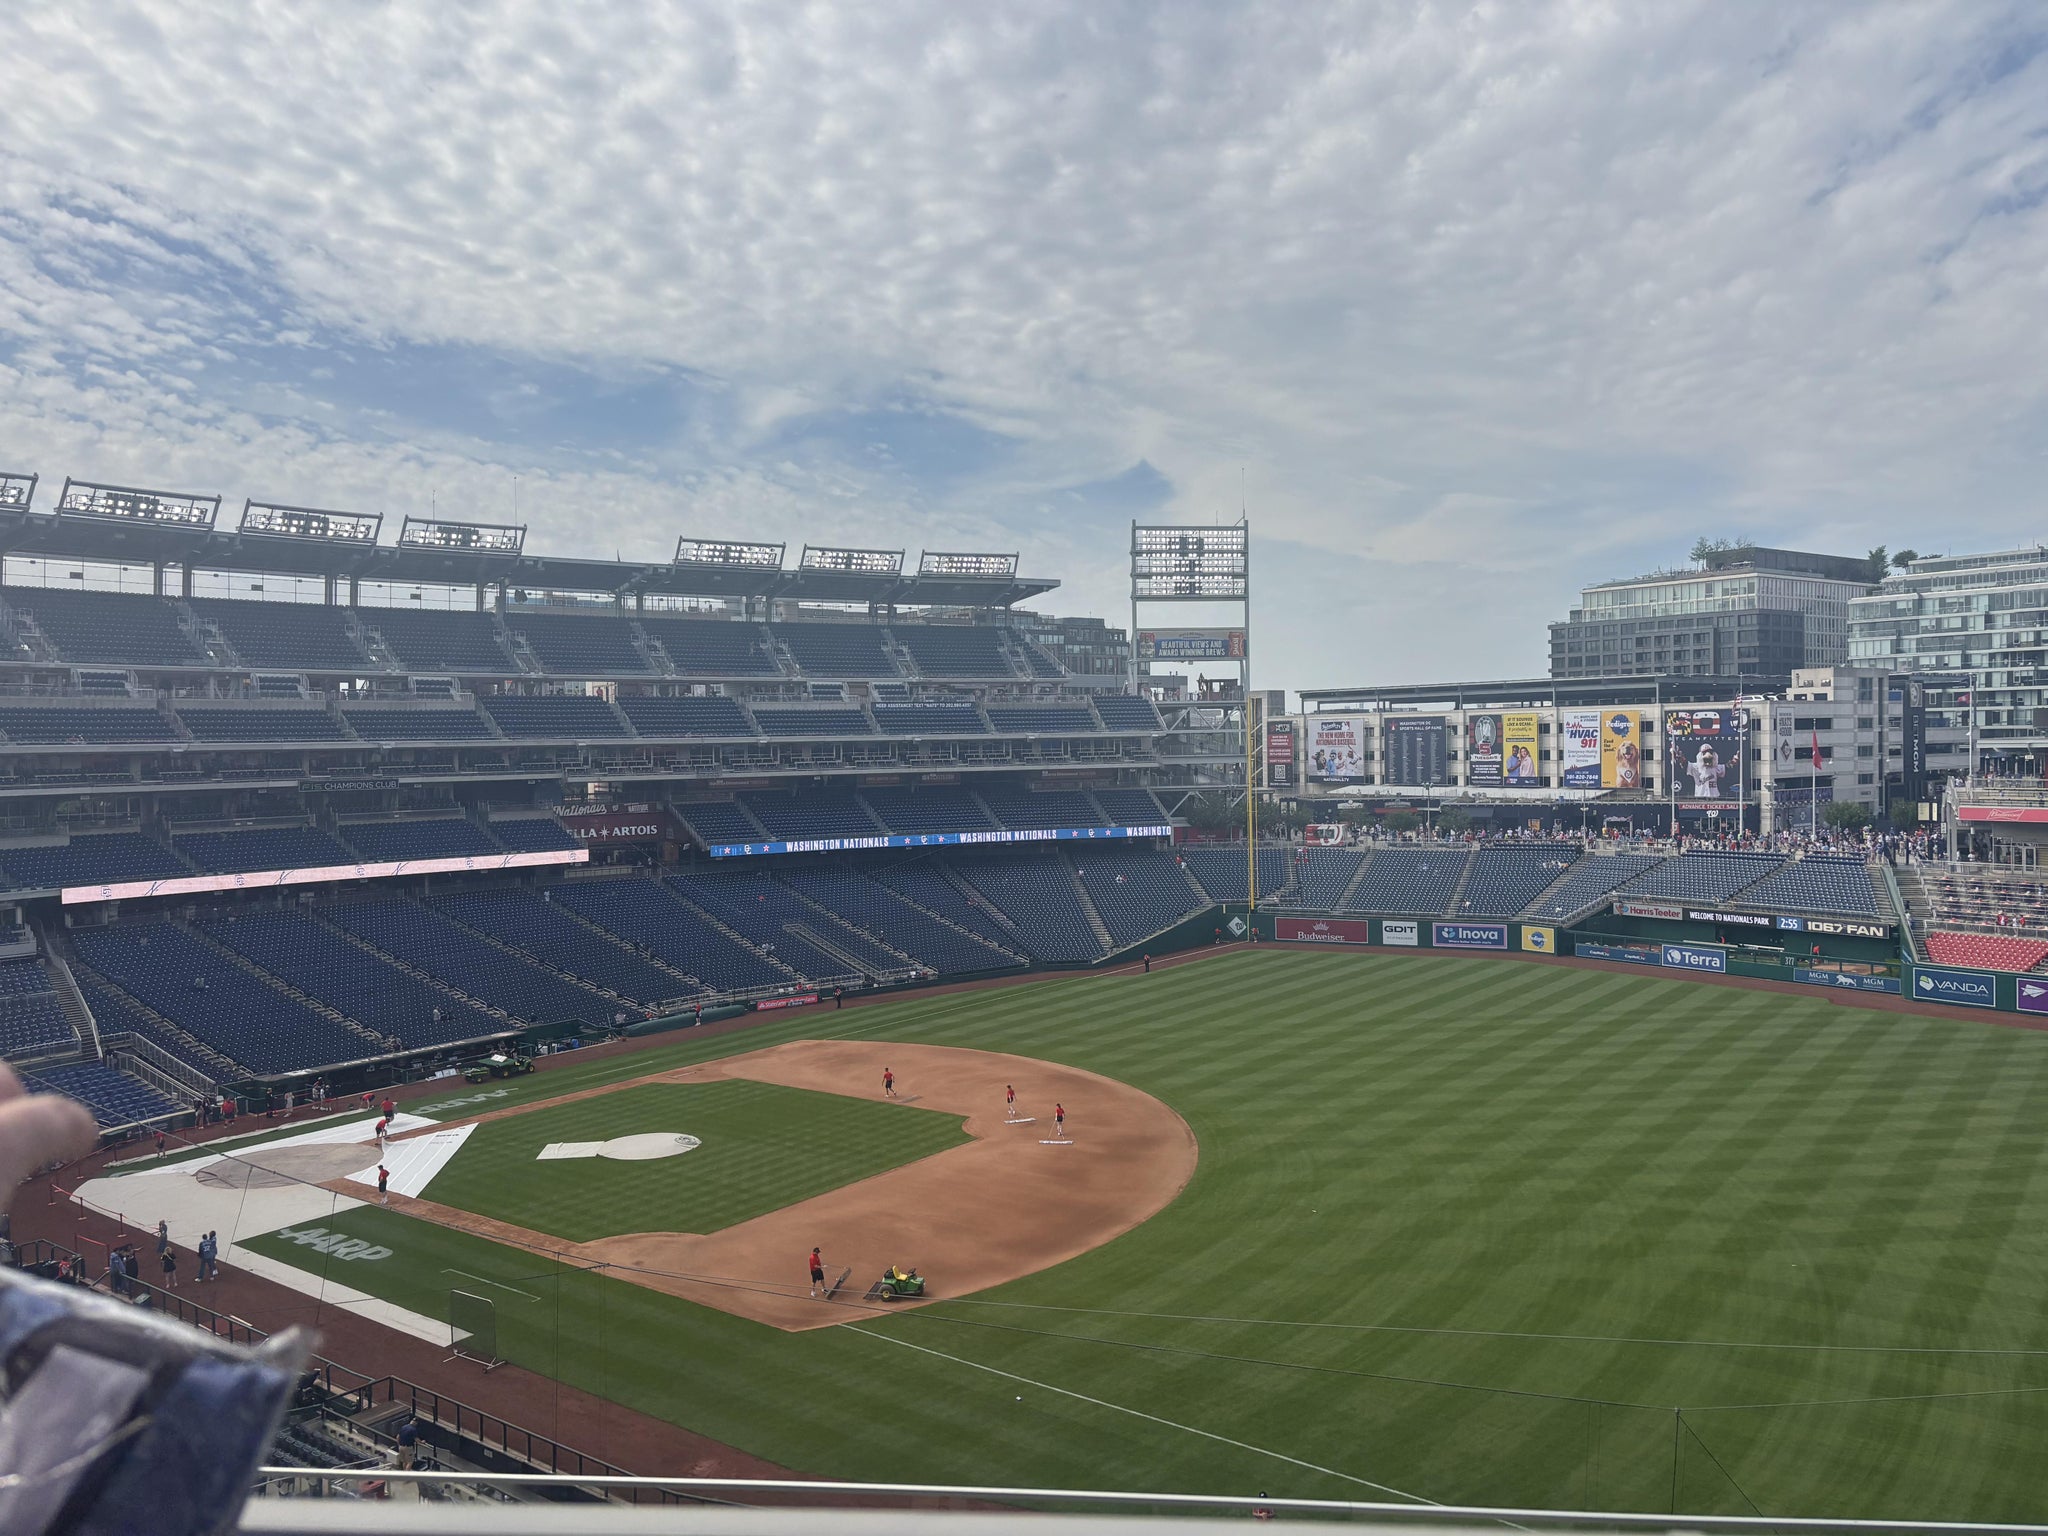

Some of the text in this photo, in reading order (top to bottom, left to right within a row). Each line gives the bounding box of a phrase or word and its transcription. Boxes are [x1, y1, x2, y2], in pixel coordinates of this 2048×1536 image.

[1161, 640, 1190, 649] BEAUTIFUL
[1191, 640, 1210, 649] VIEWS
[1210, 640, 1223, 648] AND
[1158, 648, 1226, 657] AWARD WINNING BREWS
[1605, 720, 1635, 729] Pedigree
[1570, 729, 1598, 739] HVAC
[1580, 739, 1598, 748] 911
[324, 782, 374, 791] CHAMPIONS
[375, 781, 397, 789] CLUB
[553, 803, 608, 817] Nationals
[612, 825, 658, 837] ARTOIS
[960, 829, 1057, 843] WASHINGTON NATIONALS
[1126, 825, 1172, 837] WASHINGTO
[786, 837, 889, 852] WASHINGTON NATIONALS
[1629, 905, 1681, 918] Harris Teeter
[1689, 911, 1770, 926] WELCOME TO NATIONALS PARK
[1780, 918, 1798, 929] 2:55
[1384, 925, 1417, 934] GDIT
[1458, 927, 1498, 940] Inova
[1847, 924, 1884, 937] FAN
[1297, 931, 1345, 941] Budweiser
[1682, 951, 1721, 967] Terra
[1784, 956, 1795, 966] 377
[1808, 971, 1829, 980] MGM
[1863, 977, 1884, 986] MGM
[1934, 979, 1989, 993] VANDA
[276, 1227, 394, 1261] AARP
